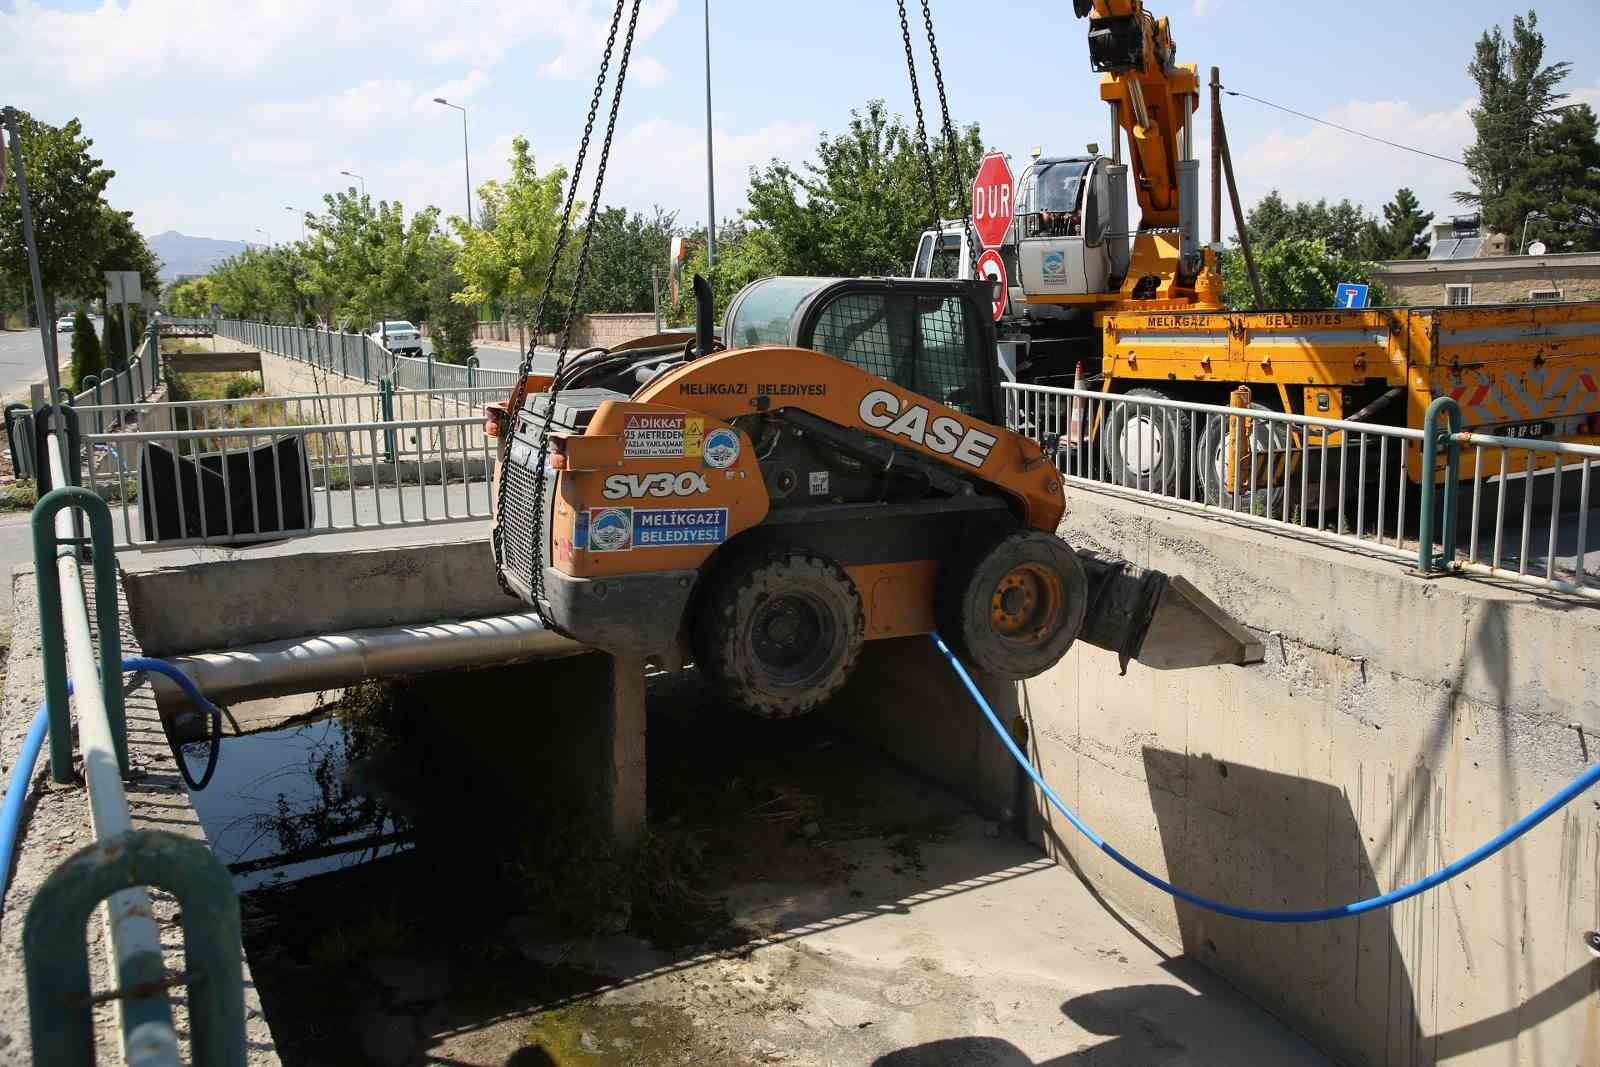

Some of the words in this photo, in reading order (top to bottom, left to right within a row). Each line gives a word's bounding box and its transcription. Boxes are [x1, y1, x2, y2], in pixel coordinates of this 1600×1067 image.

[976, 186, 1011, 219] DUR
[641, 415, 683, 429] DİKKAT
[858, 389, 999, 468] CASE
[638, 430, 684, 440] METREDEN
[641, 511, 720, 526] MELİKGAZİ
[641, 527, 720, 542] BELEDİYESİ
